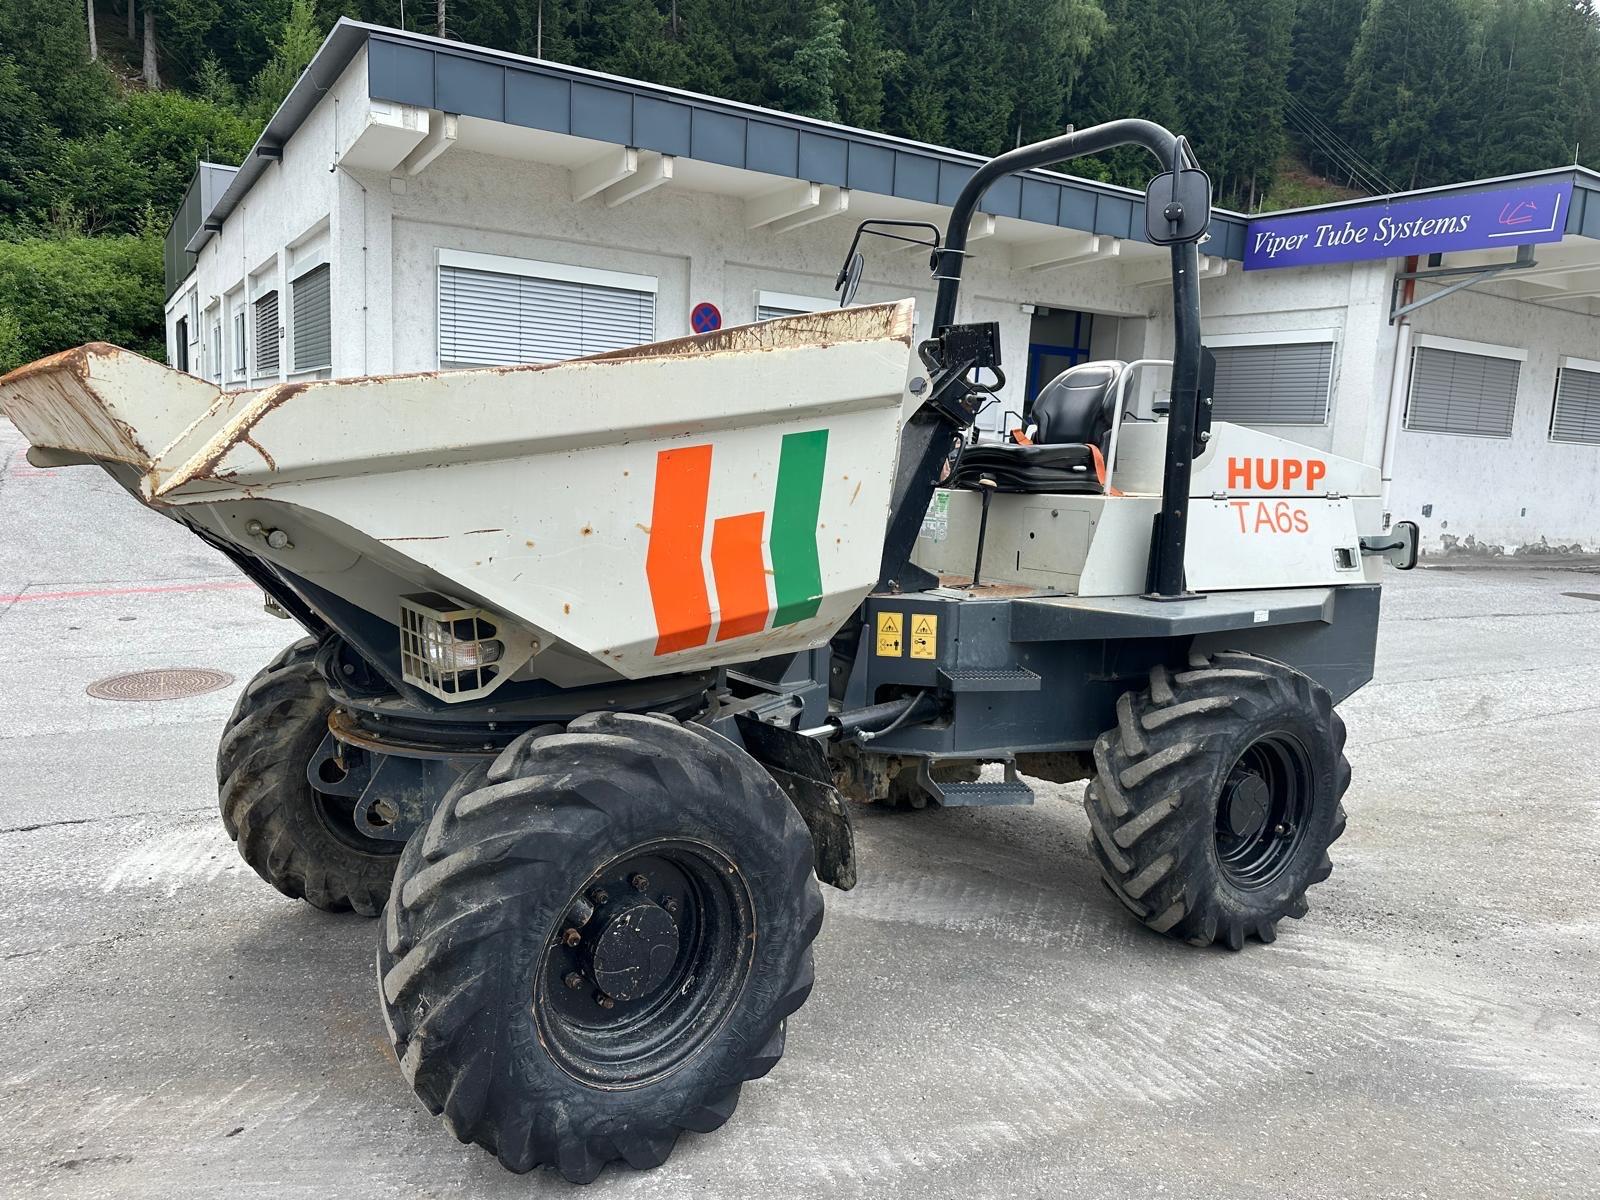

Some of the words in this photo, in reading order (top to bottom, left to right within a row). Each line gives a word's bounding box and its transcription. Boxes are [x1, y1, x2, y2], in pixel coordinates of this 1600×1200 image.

[1254, 231, 1309, 258] Viper
[1313, 221, 1369, 248] Tube
[1372, 214, 1471, 247] Systems
[1227, 457, 1327, 491] HUPP
[1230, 501, 1309, 534] TA6s
